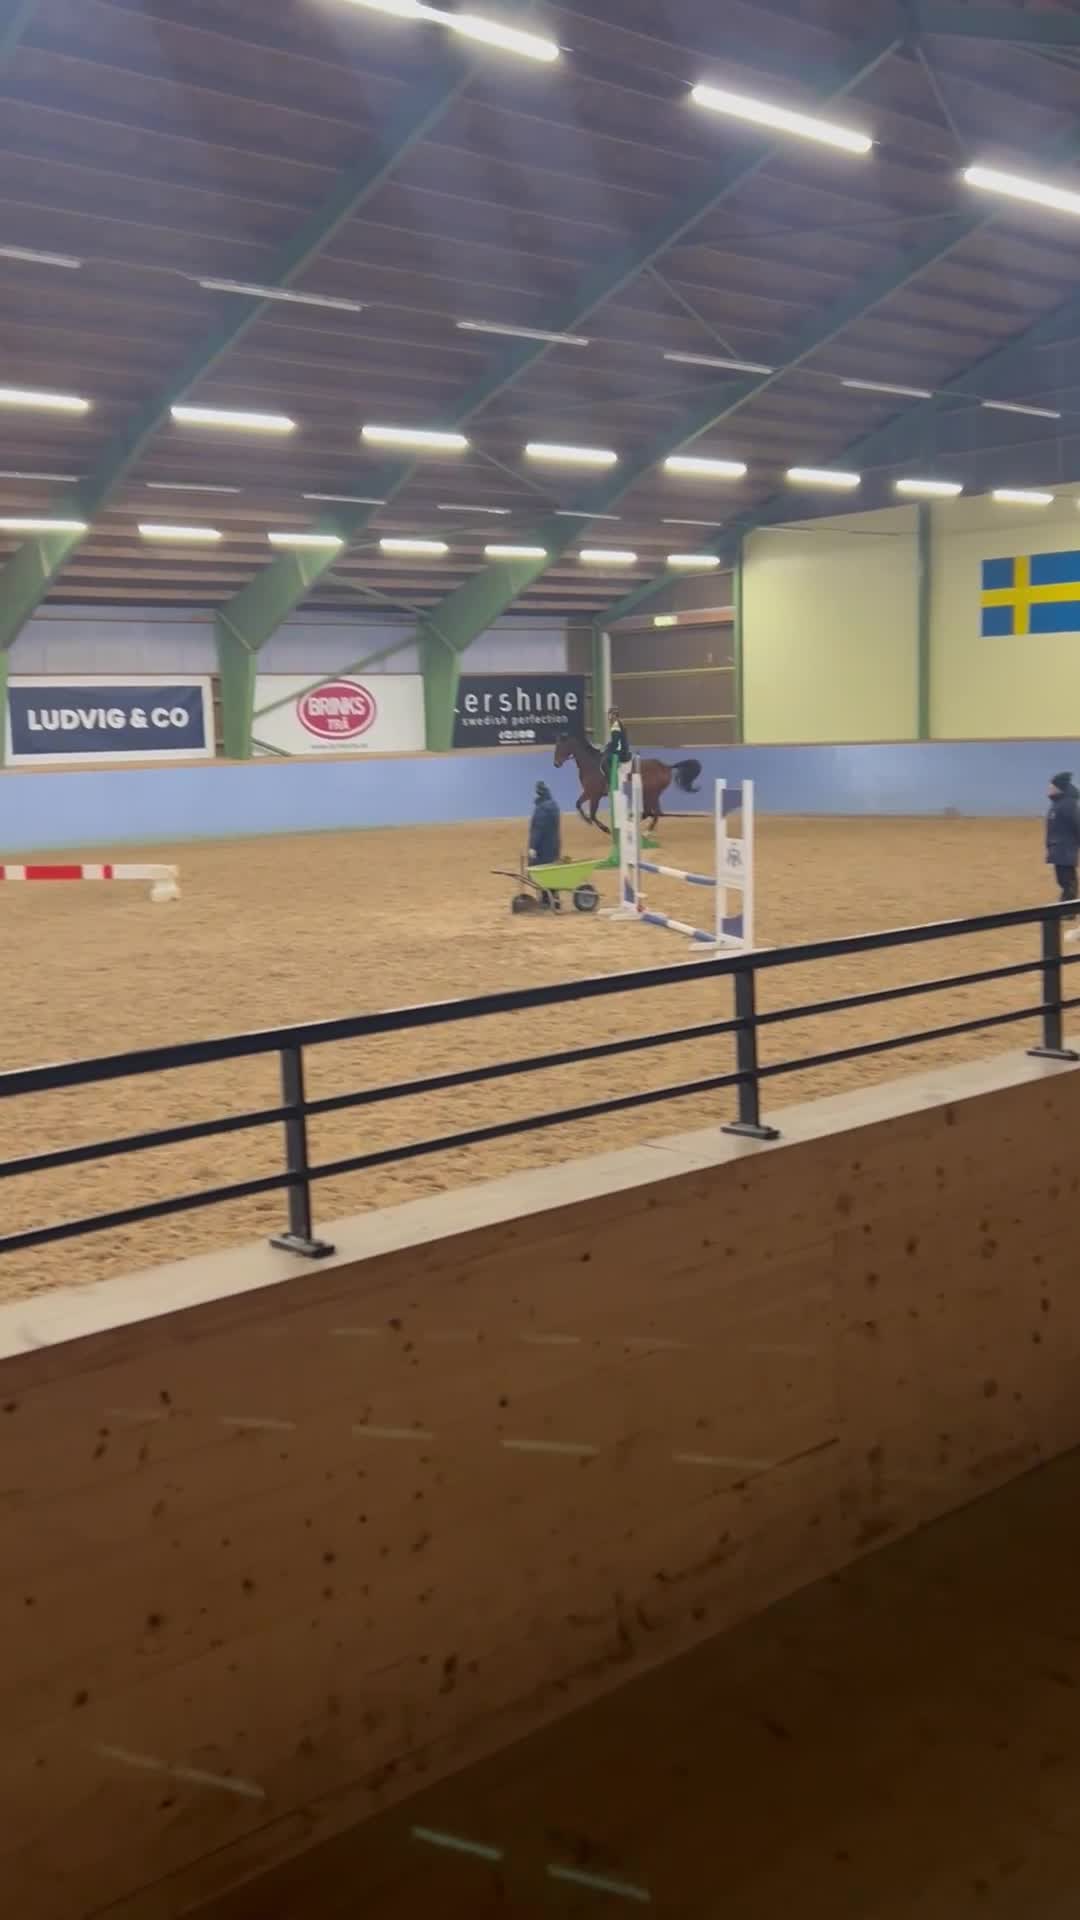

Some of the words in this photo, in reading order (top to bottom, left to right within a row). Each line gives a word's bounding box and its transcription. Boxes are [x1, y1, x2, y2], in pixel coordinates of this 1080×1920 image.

[309, 697, 367, 716] BRINKS
[453, 687, 578, 713] ershine
[27, 708, 126, 730] LUDVIG
[129, 707, 149, 728] &
[151, 707, 189, 728] CO
[461, 716, 508, 726] swedish
[511, 714, 569, 726] perfection
